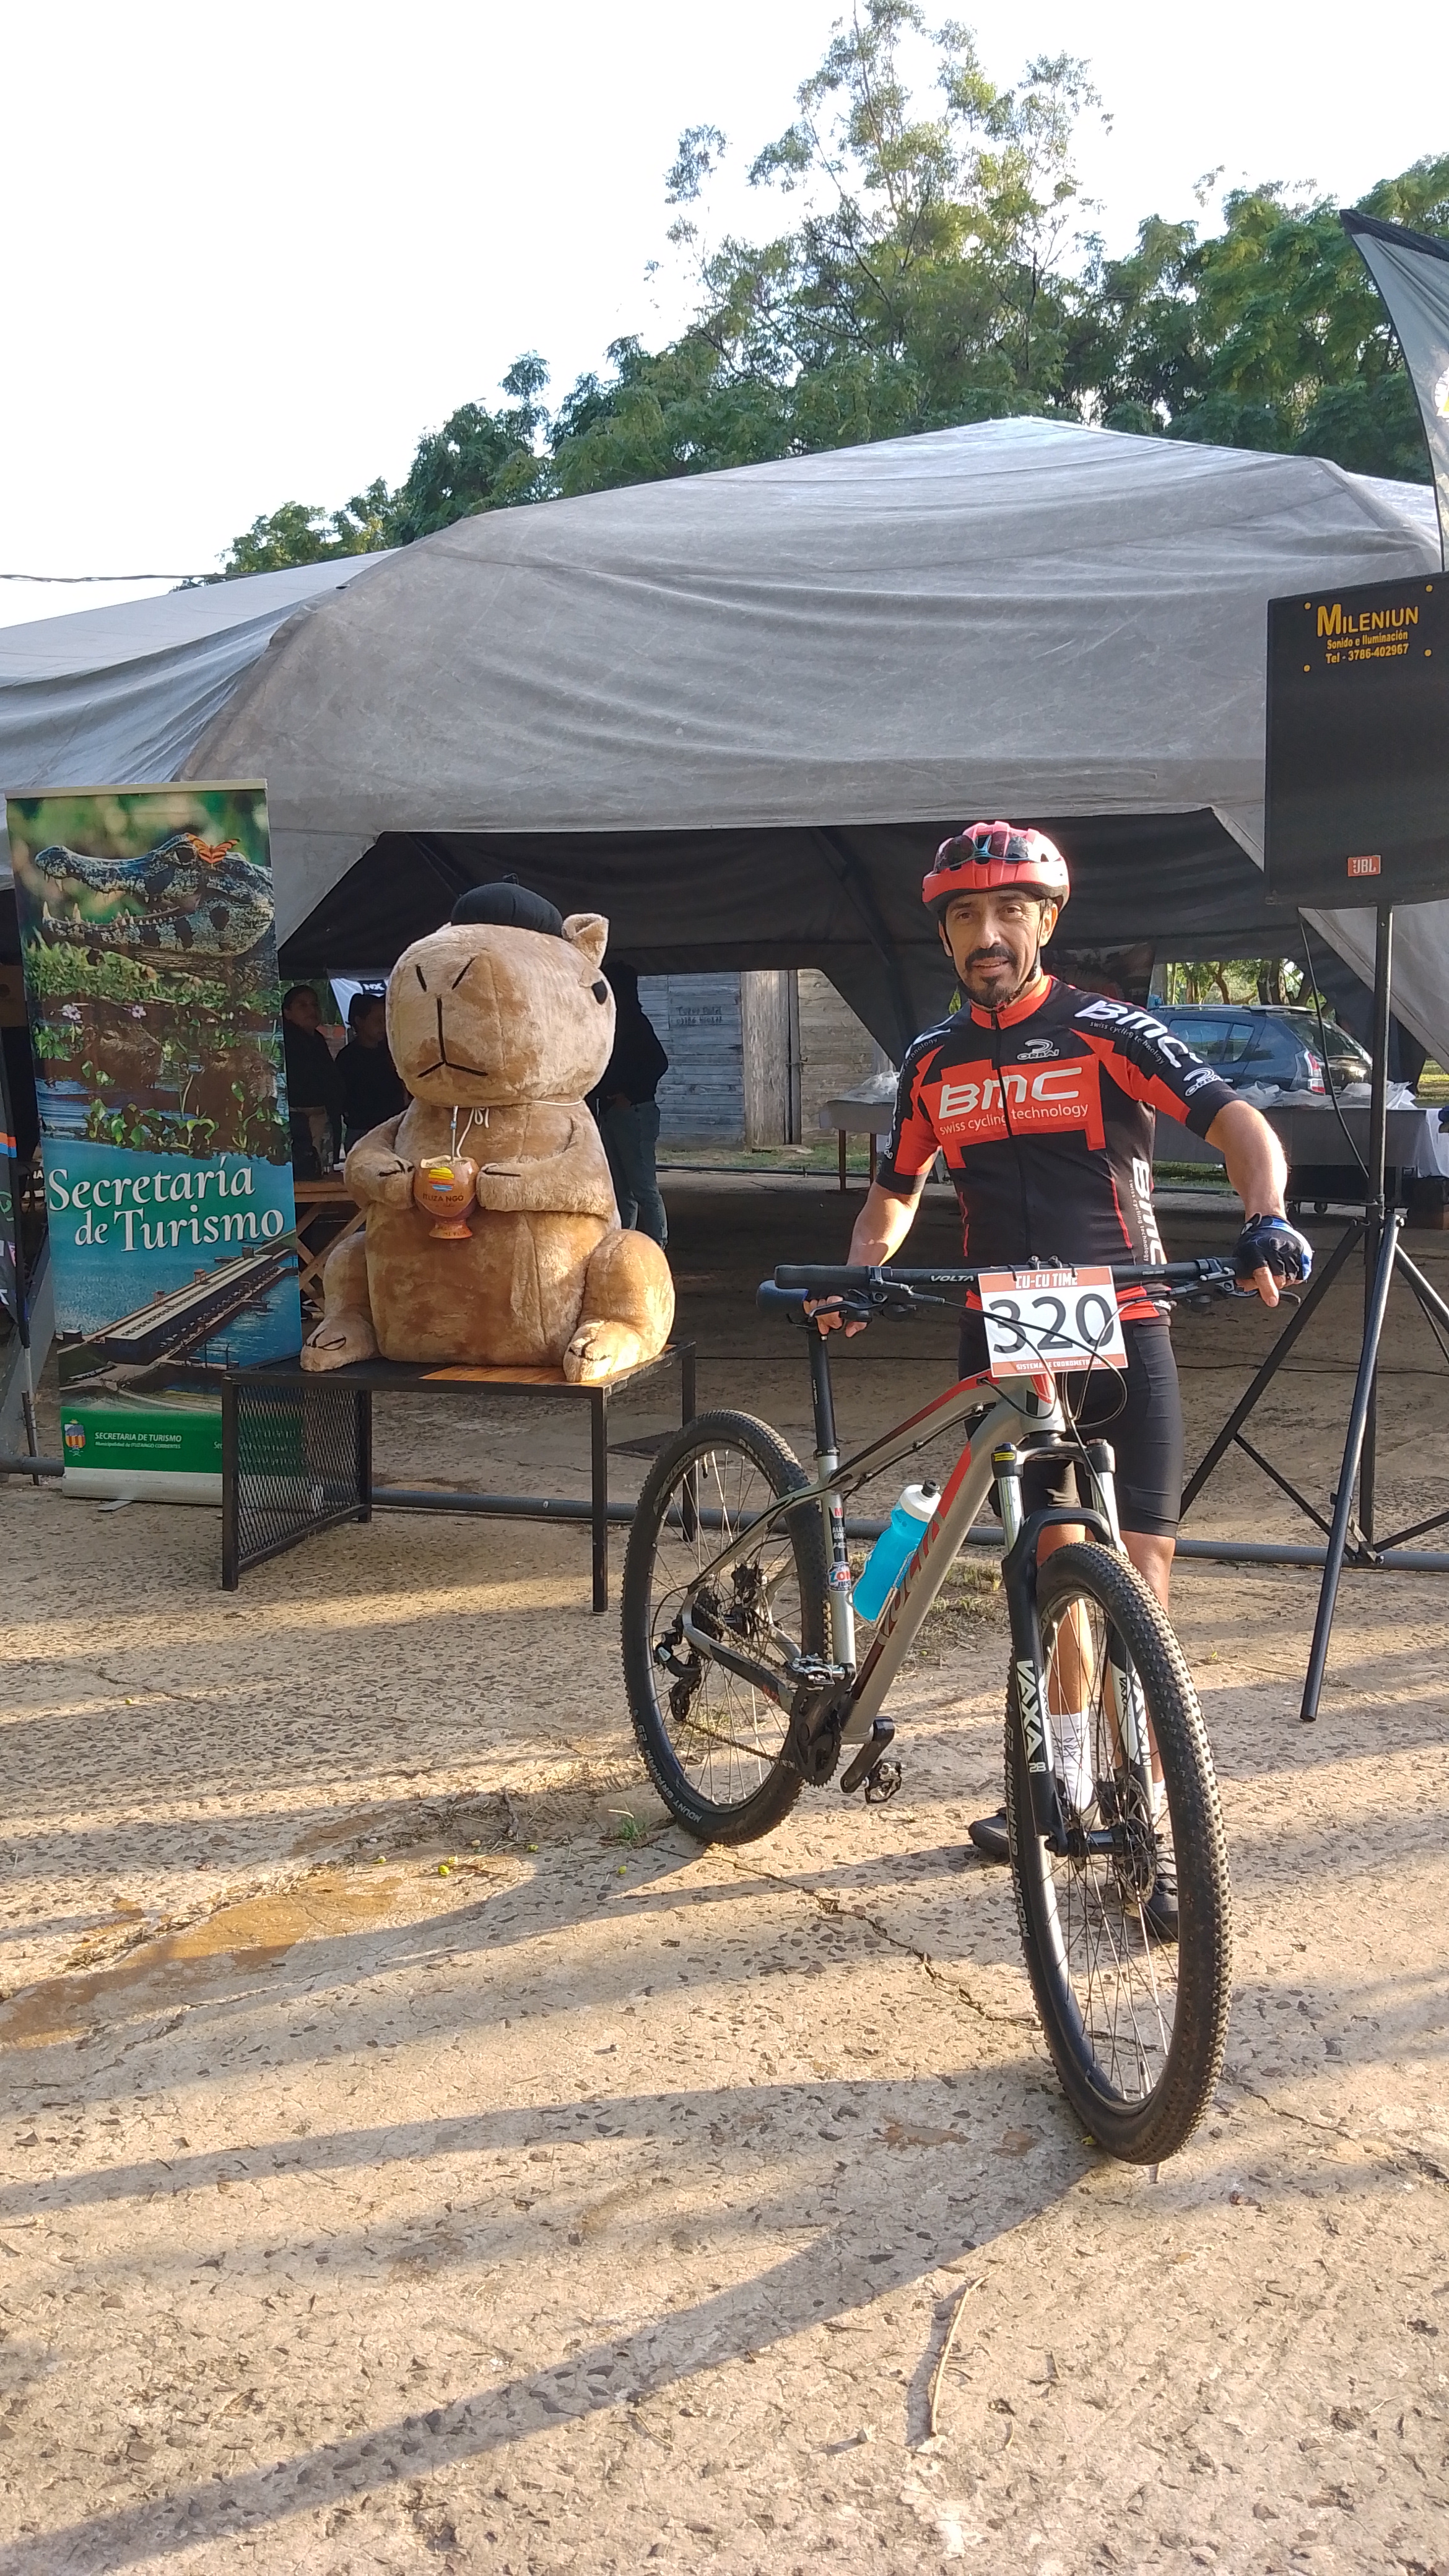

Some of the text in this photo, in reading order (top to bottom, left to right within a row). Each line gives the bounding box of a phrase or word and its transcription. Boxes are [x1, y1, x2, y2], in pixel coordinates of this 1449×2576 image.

[1317, 604, 1419, 637] MILENIUN
[1327, 629, 1408, 650] Sonido e Iluminación
[1325, 652, 1340, 664] Tel
[1352, 858, 1377, 874] JBL
[1089, 1021, 1108, 1030] swiss
[939, 1103, 1089, 1136] swiss cycling technology
[48, 1155, 256, 1211] Secretaría
[75, 1204, 285, 1252] de Turismo
[930, 1274, 975, 1282] VOLTA
[988, 1292, 1115, 1354] 320
[1016, 1362, 1044, 1370] SISTEMA
[94, 1432, 182, 1443] SECRETARIA DE TURISMO
[645, 1749, 675, 1800] GRAHAM
[672, 1799, 703, 1824] MOUNT
[1012, 1861, 1031, 1939] MOUNT
